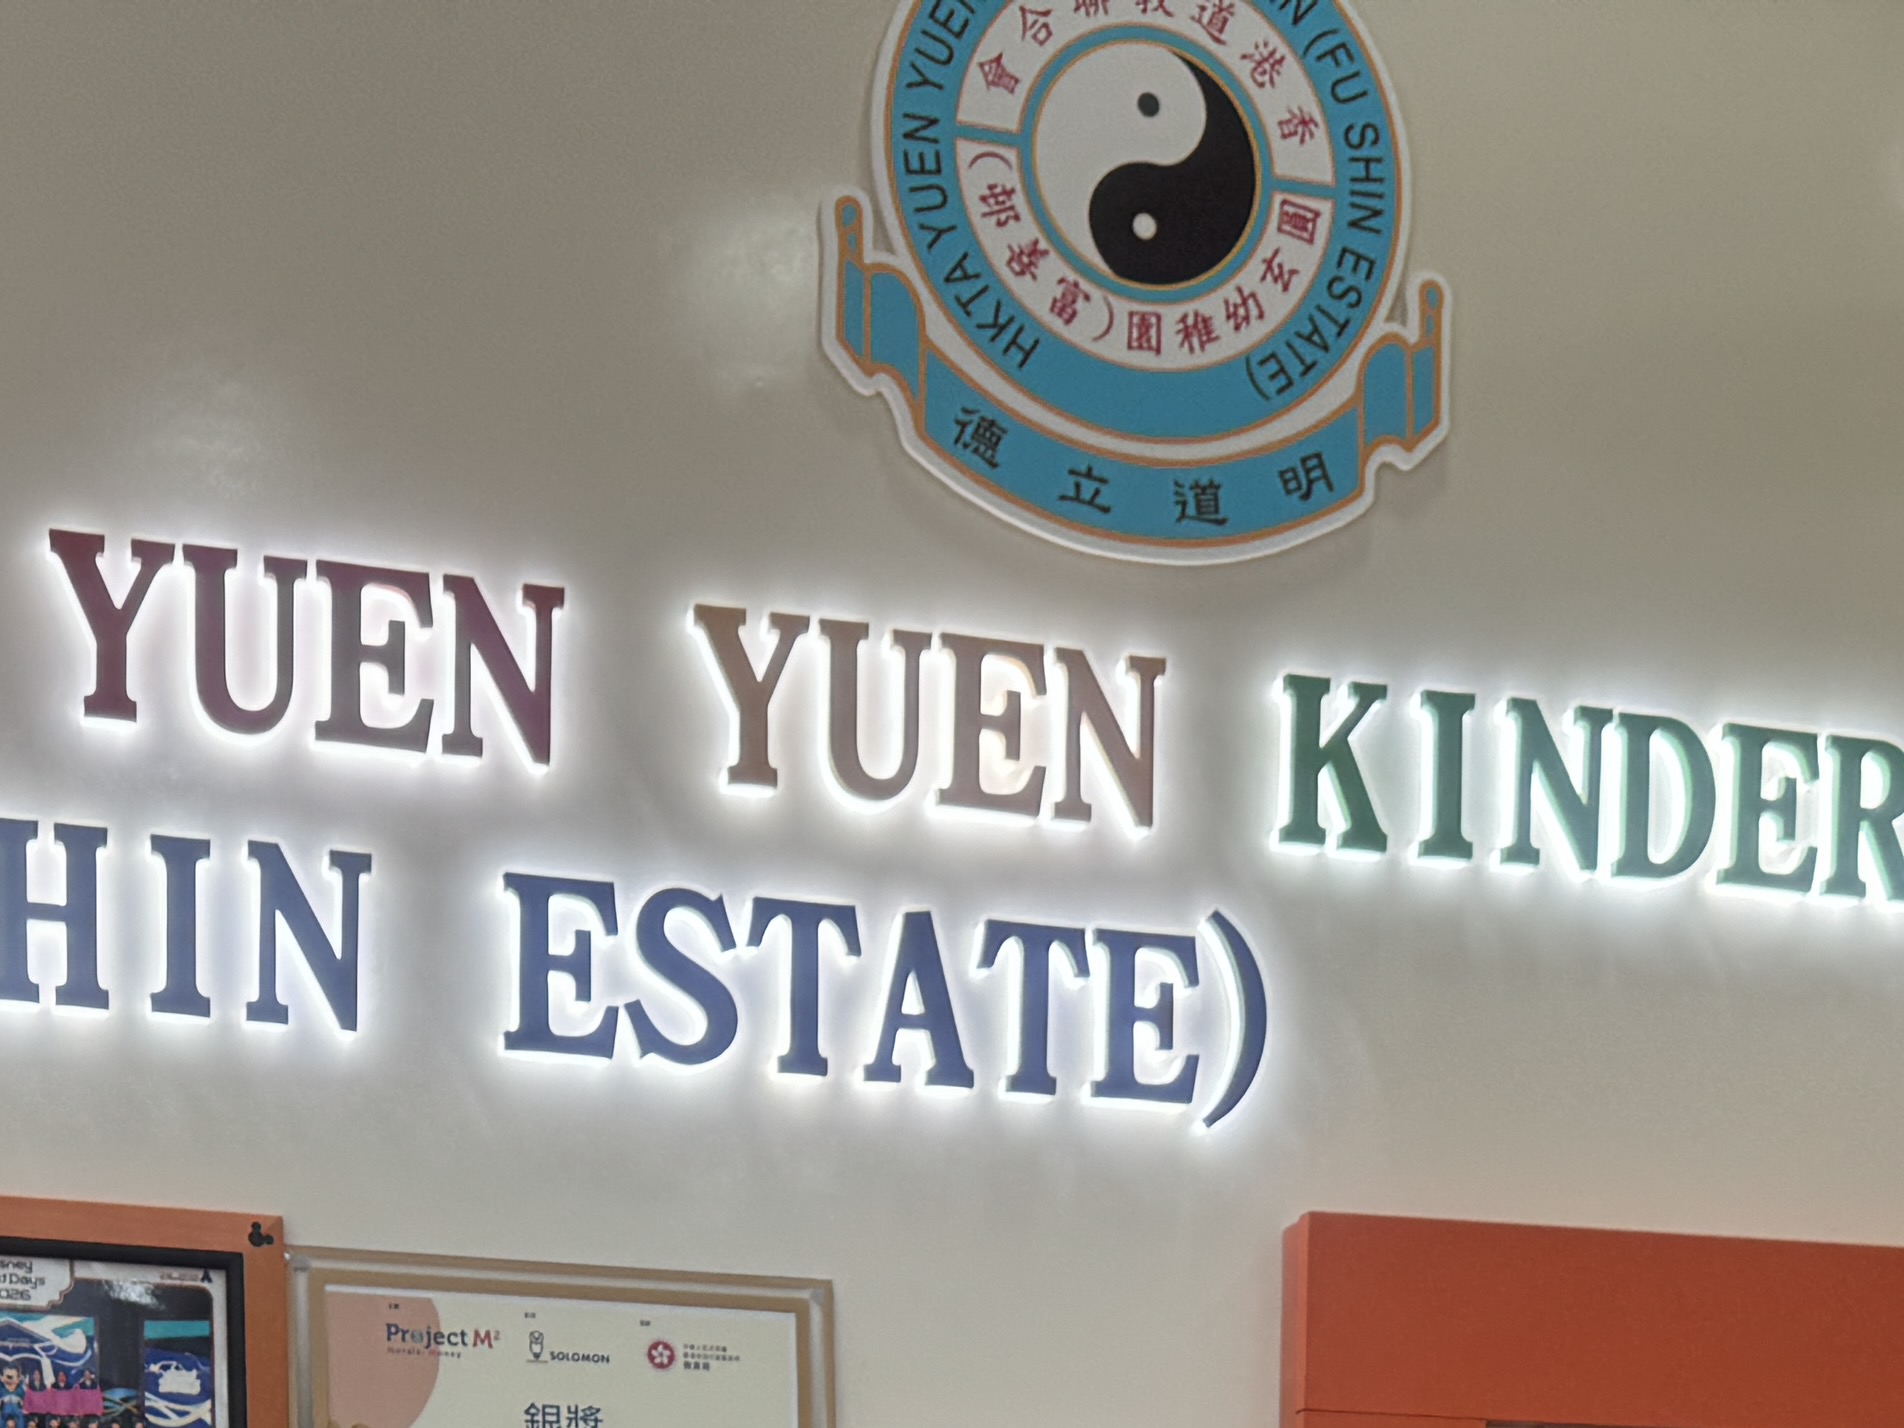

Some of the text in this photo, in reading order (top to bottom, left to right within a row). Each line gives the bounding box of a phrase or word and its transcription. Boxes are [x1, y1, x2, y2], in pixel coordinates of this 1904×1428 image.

[906, 0, 976, 90] YUE
[902, 111, 1040, 371] HKTA YUEN
[1342, 121, 1386, 235] SHIN
[1246, 246, 1375, 401] ESTATE)
[47, 527, 566, 770] YUEN
[690, 602, 1168, 837] YUEN
[500, 870, 1267, 1131] ESTATE)
[385, 1322, 468, 1349] Project
[549, 1350, 611, 1365] SOLOMON
